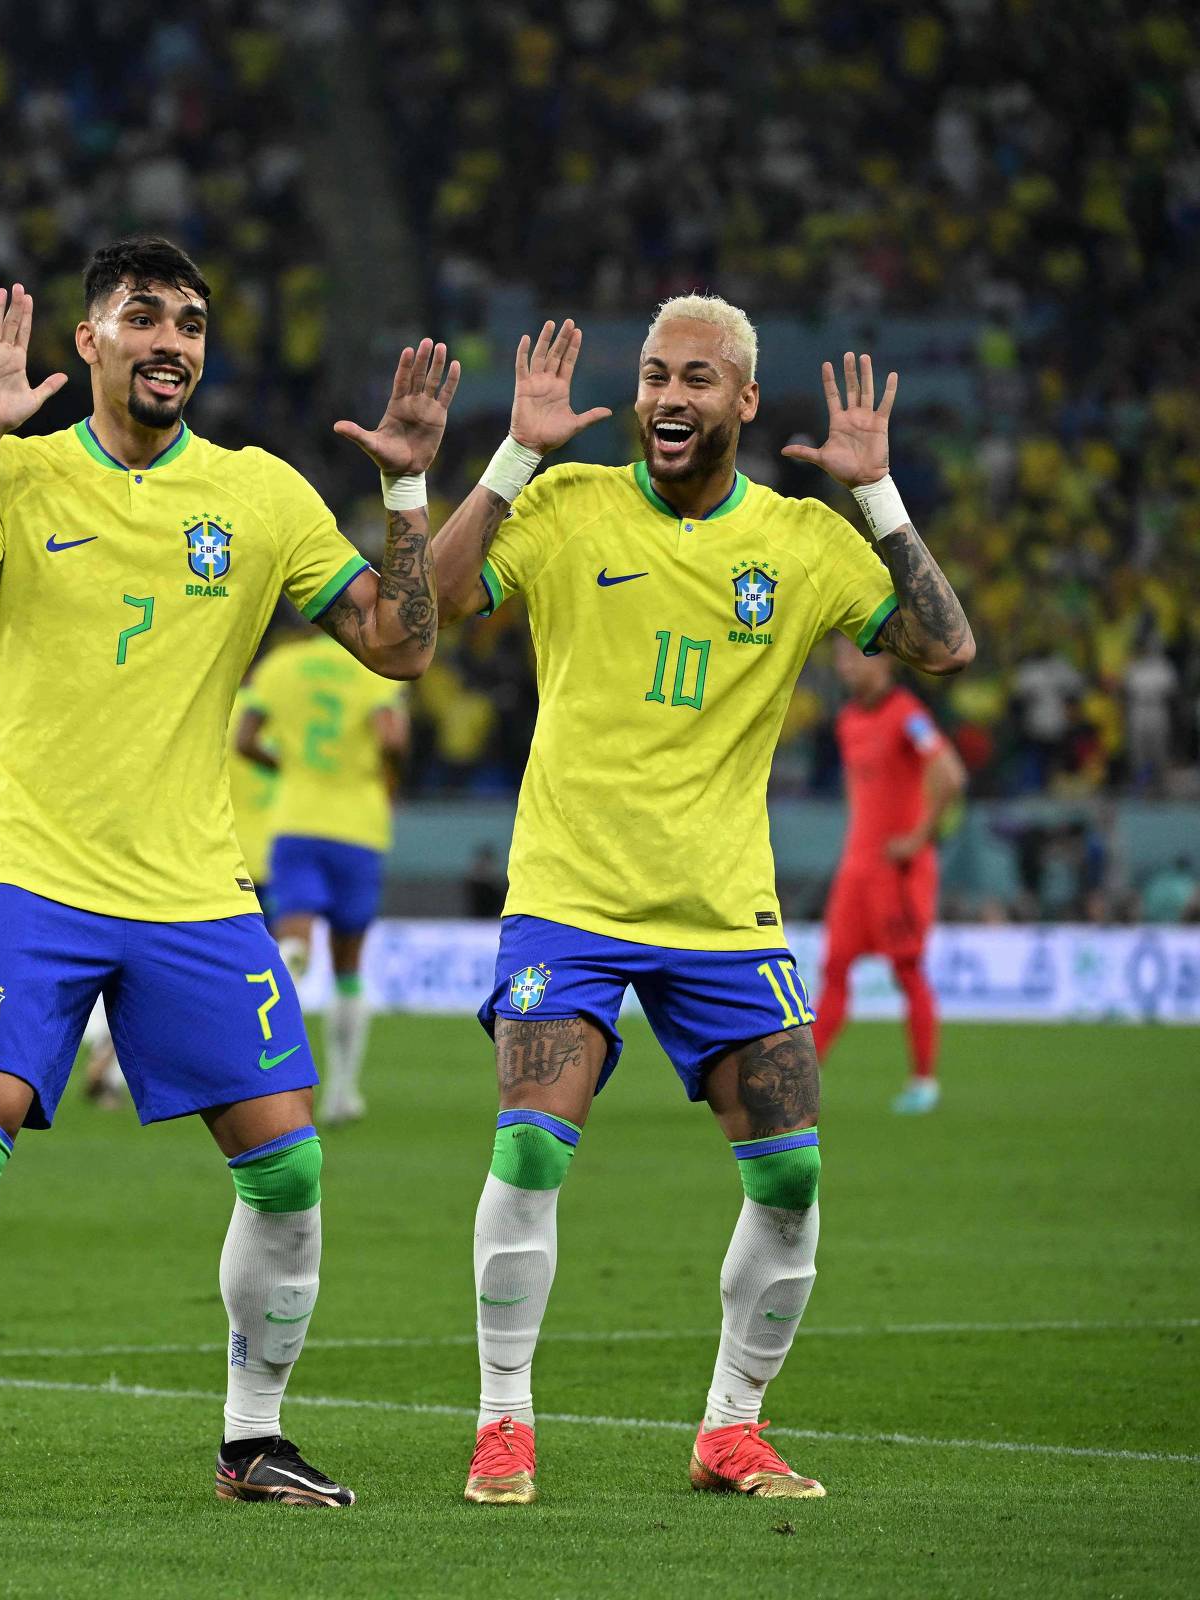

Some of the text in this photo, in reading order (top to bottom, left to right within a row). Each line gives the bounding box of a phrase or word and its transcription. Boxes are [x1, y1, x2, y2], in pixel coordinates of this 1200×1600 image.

[200, 545, 217, 554] CBF
[185, 584, 229, 597] BRASIL
[745, 593, 762, 602] CBF
[117, 594, 154, 665] 7
[728, 631, 773, 645] BRASIL
[645, 630, 711, 710] 10
[305, 690, 342, 772] 2
[245, 968, 281, 1041] 7
[231, 1331, 247, 1368] BRASIL
